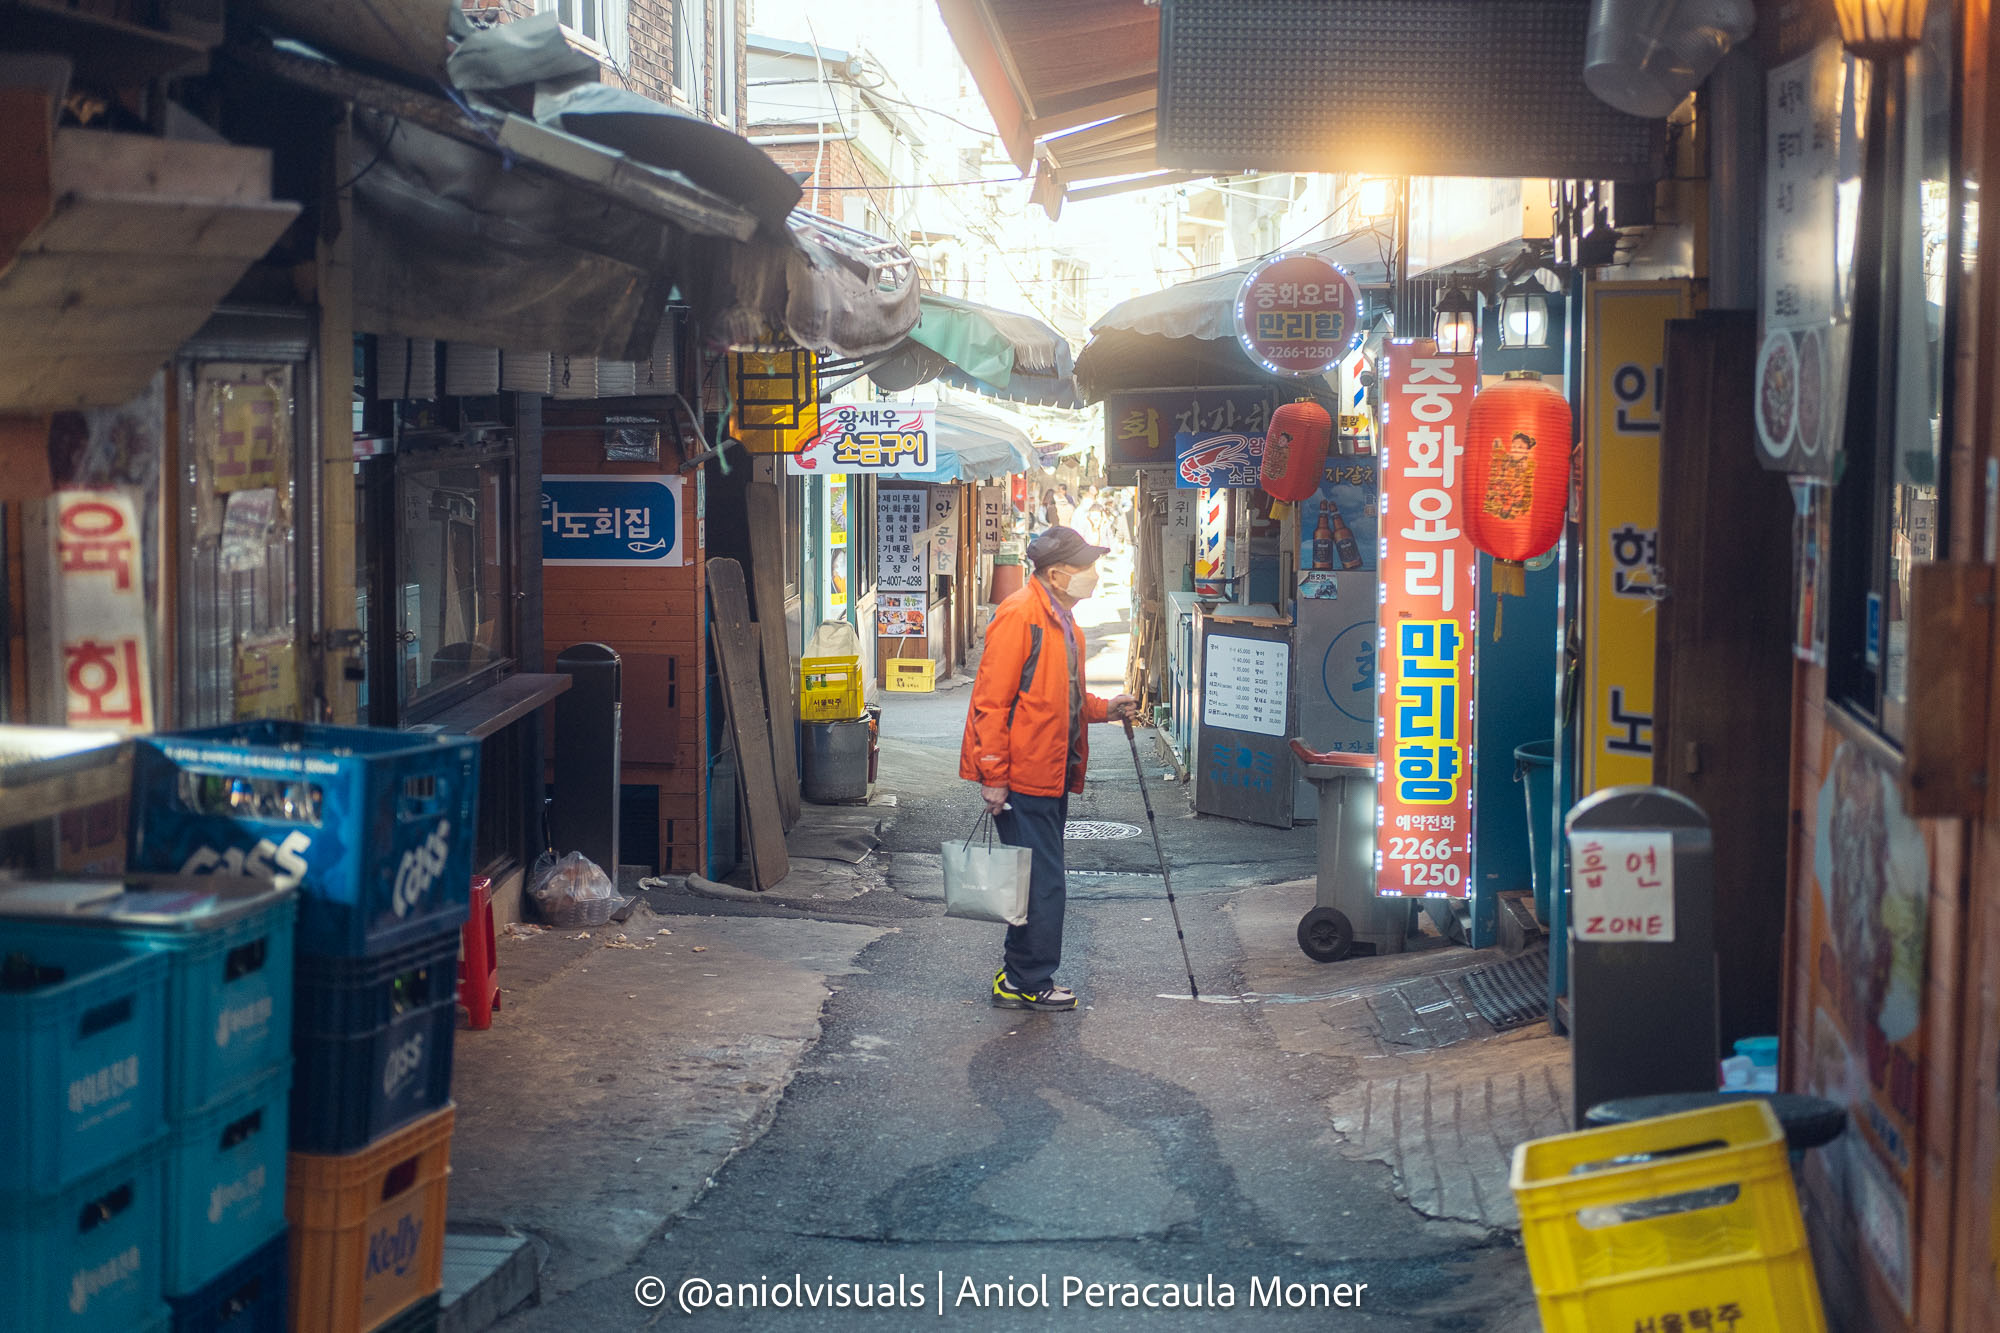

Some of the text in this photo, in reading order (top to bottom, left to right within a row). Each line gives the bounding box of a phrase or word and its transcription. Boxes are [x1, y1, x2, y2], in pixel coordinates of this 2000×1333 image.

[1255, 283, 1344, 308] 중화요리
[1257, 312, 1344, 340] 만리향
[1267, 346, 1333, 358] 2266-1250
[838, 410, 900, 432] 왕새우
[1118, 408, 1160, 449] 회
[835, 432, 927, 466] 소금구이
[1248, 437, 1266, 457] 왕
[1228, 466, 1263, 485] 소금
[1400, 358, 1465, 612] 중화요리
[878, 494, 920, 503] 재미무침
[985, 503, 998, 542] 진미네
[1174, 500, 1189, 528] 쥐치
[878, 524, 920, 533] 어삼합
[878, 545, 913, 553] 기매운
[878, 555, 920, 563] 오징어
[878, 565, 920, 573] 장어
[1397, 621, 1463, 803] 만리향
[1396, 815, 1456, 832] 예약전화
[1389, 837, 1463, 860] 2266-
[1401, 863, 1461, 886] 1250
[1584, 915, 1664, 936] ZONE
[365, 1213, 424, 1280] Kelly
